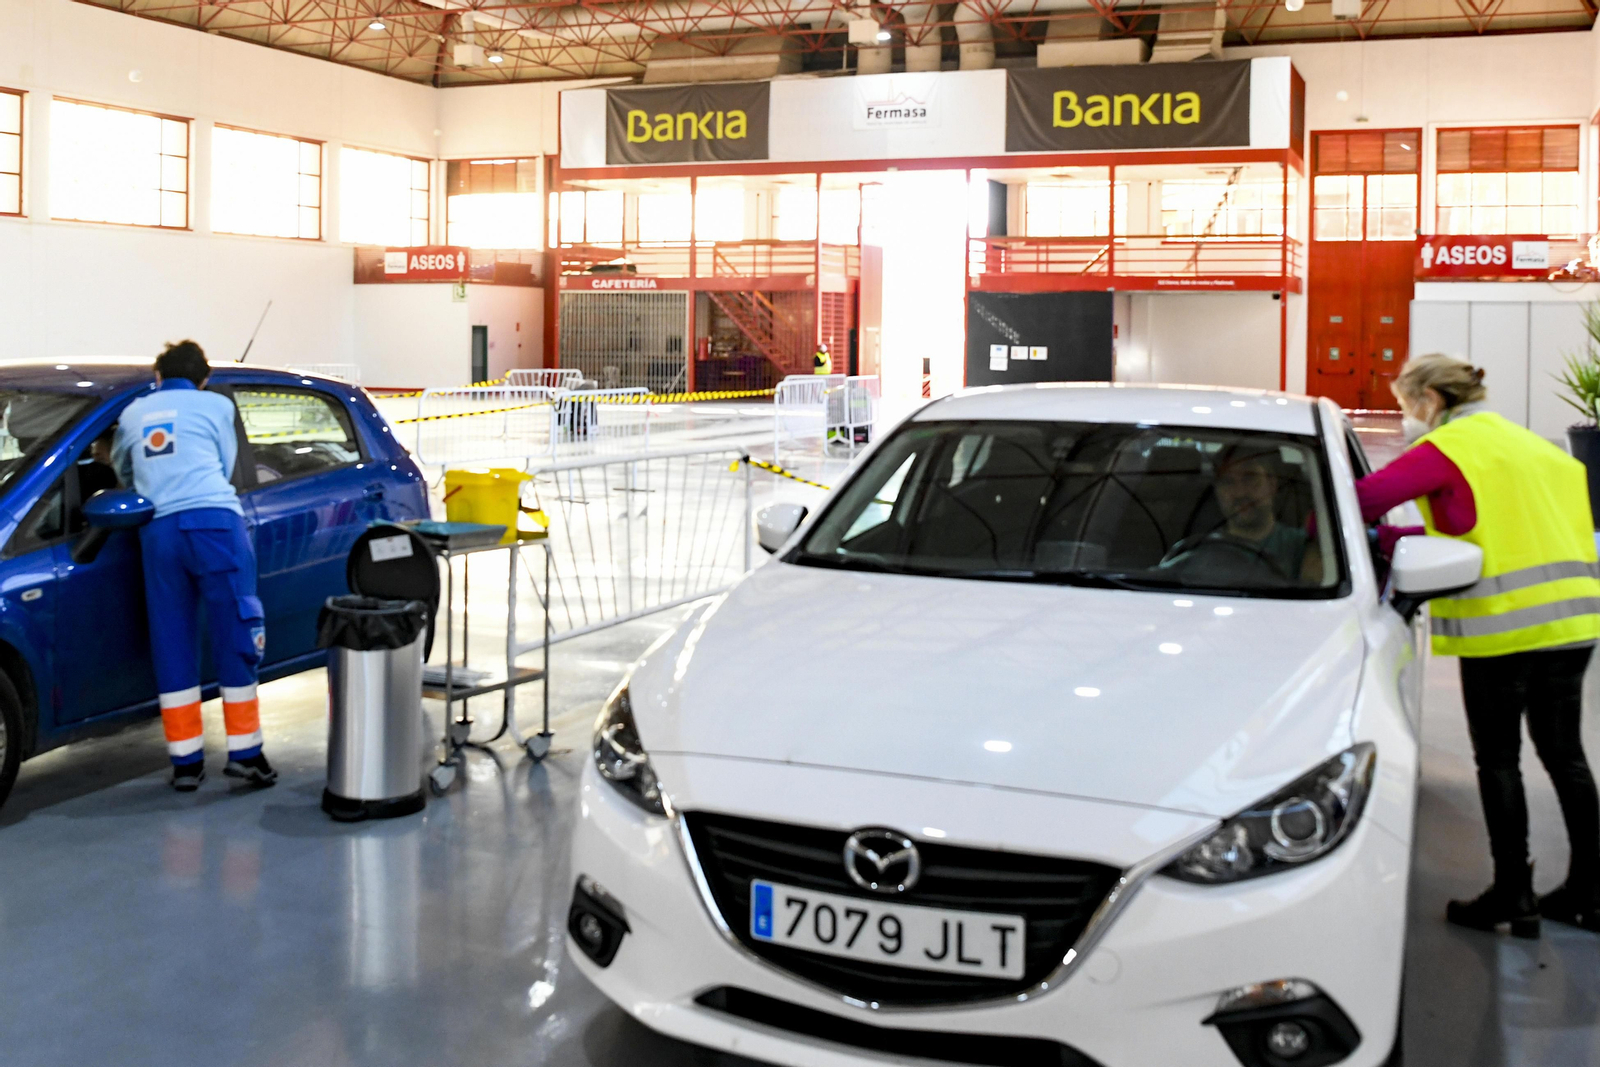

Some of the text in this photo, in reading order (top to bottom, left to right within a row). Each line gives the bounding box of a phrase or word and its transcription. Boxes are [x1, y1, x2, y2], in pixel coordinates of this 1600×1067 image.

[867, 107, 926, 119] Fermasa
[1053, 90, 1200, 128] Bankia
[627, 109, 747, 143] Bankia
[409, 254, 455, 270] ASEOS
[1435, 245, 1507, 265] ASEOS
[591, 278, 657, 289] CAFETERÍA
[785, 896, 903, 955] 7079
[924, 919, 1016, 967] JLT
